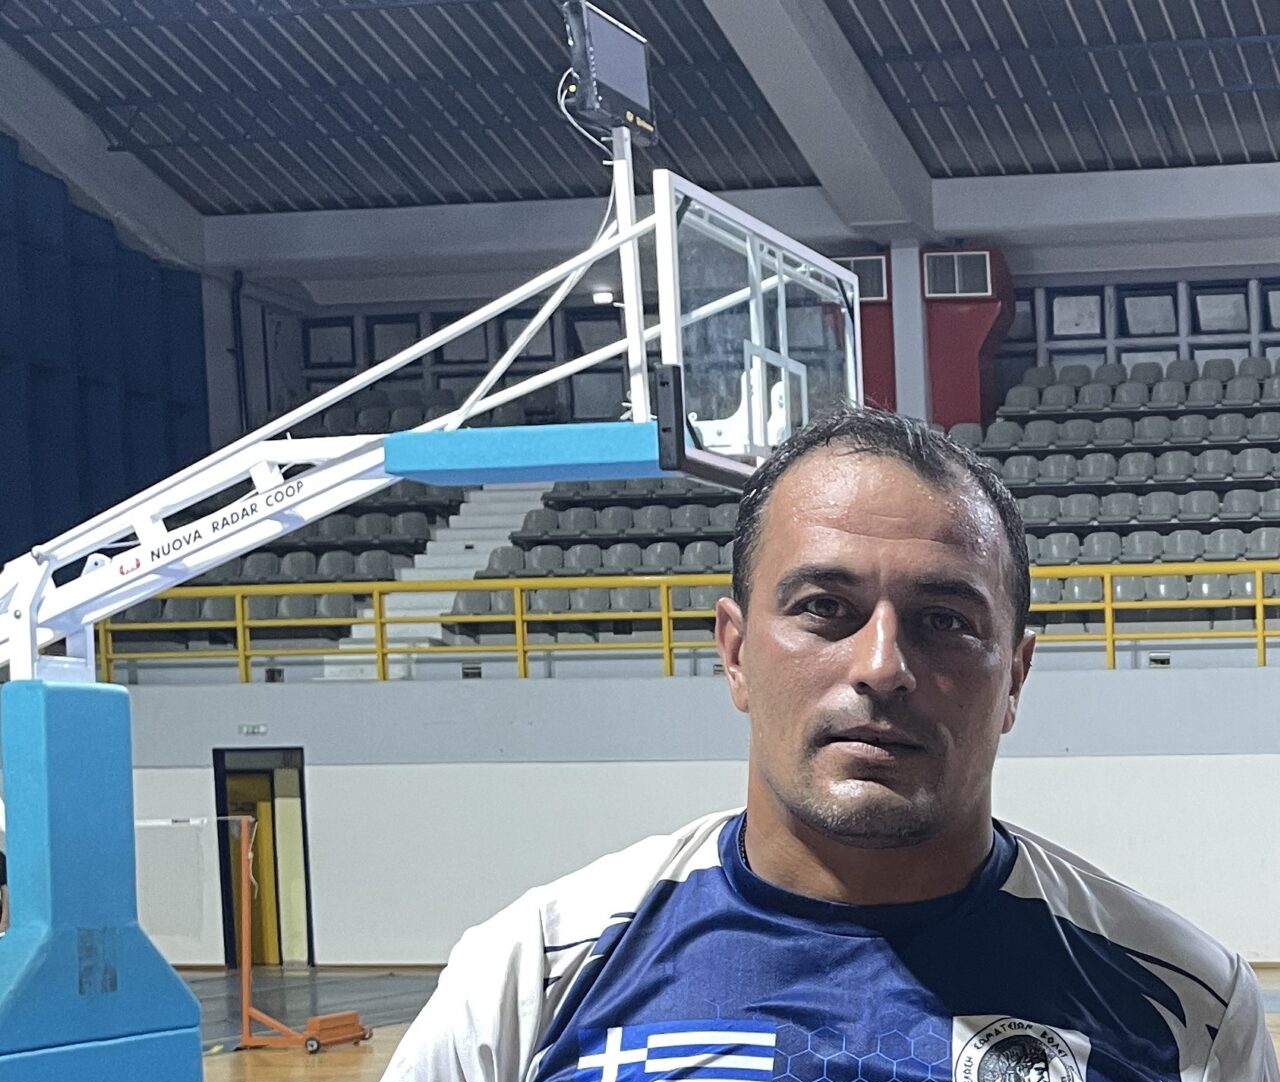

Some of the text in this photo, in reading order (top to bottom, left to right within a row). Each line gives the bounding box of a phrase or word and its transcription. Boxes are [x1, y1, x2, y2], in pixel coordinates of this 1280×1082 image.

[150, 480, 304, 562] NUOVA RADAR COOP
